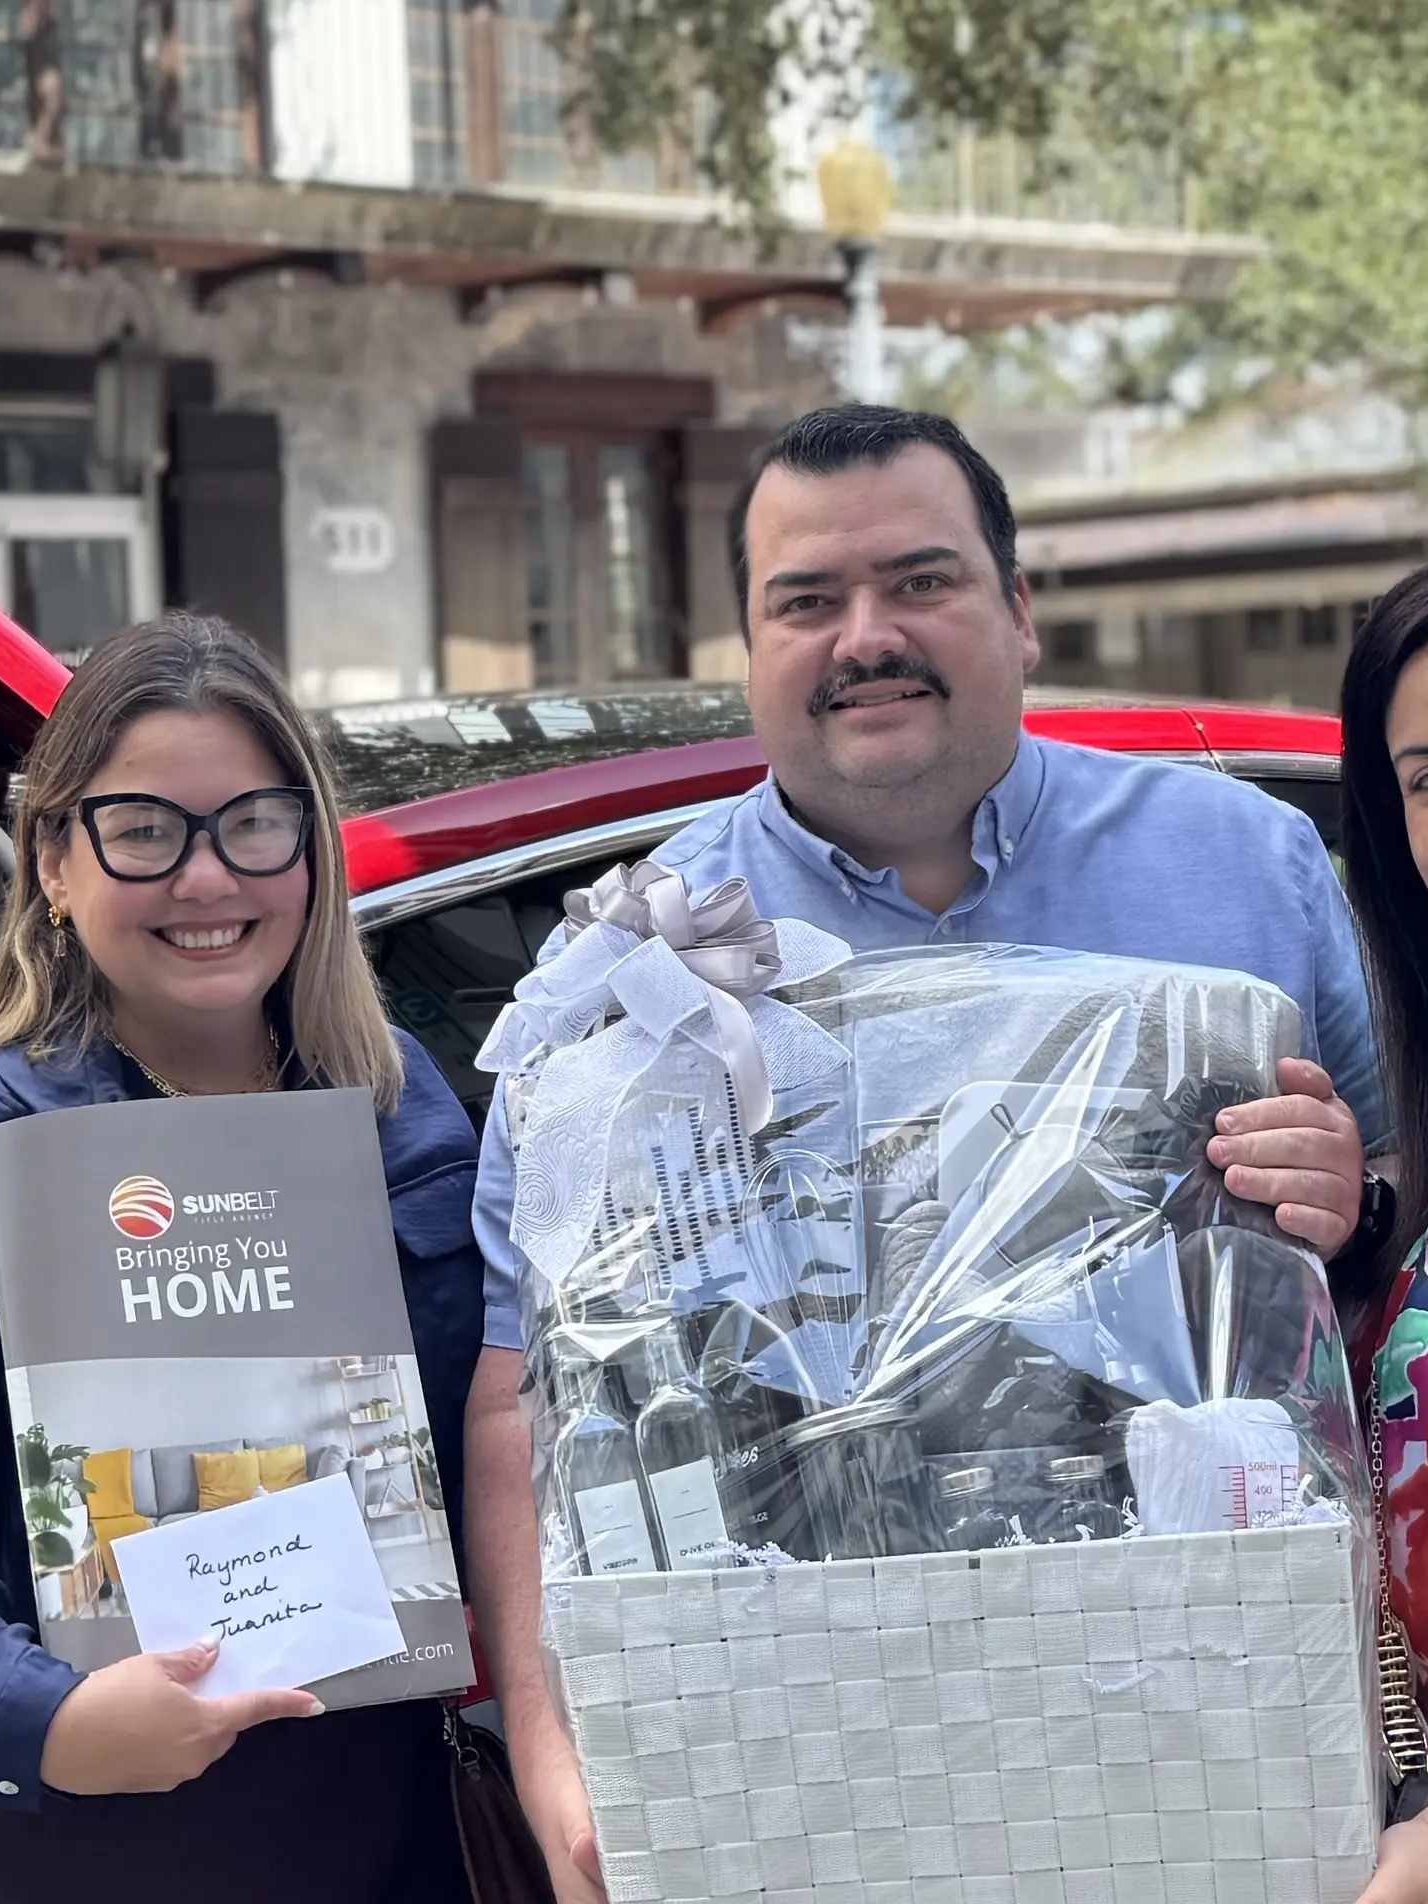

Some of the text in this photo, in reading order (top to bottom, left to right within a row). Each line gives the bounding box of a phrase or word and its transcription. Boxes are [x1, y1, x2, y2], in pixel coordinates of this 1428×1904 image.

[182, 1189, 279, 1215] SUNBELT
[115, 1235, 288, 1272] Bringing You
[120, 1265, 294, 1324] HOME
[185, 1534, 313, 1586] Raymond
[223, 1576, 279, 1604] and
[210, 1599, 323, 1641] Juanita
